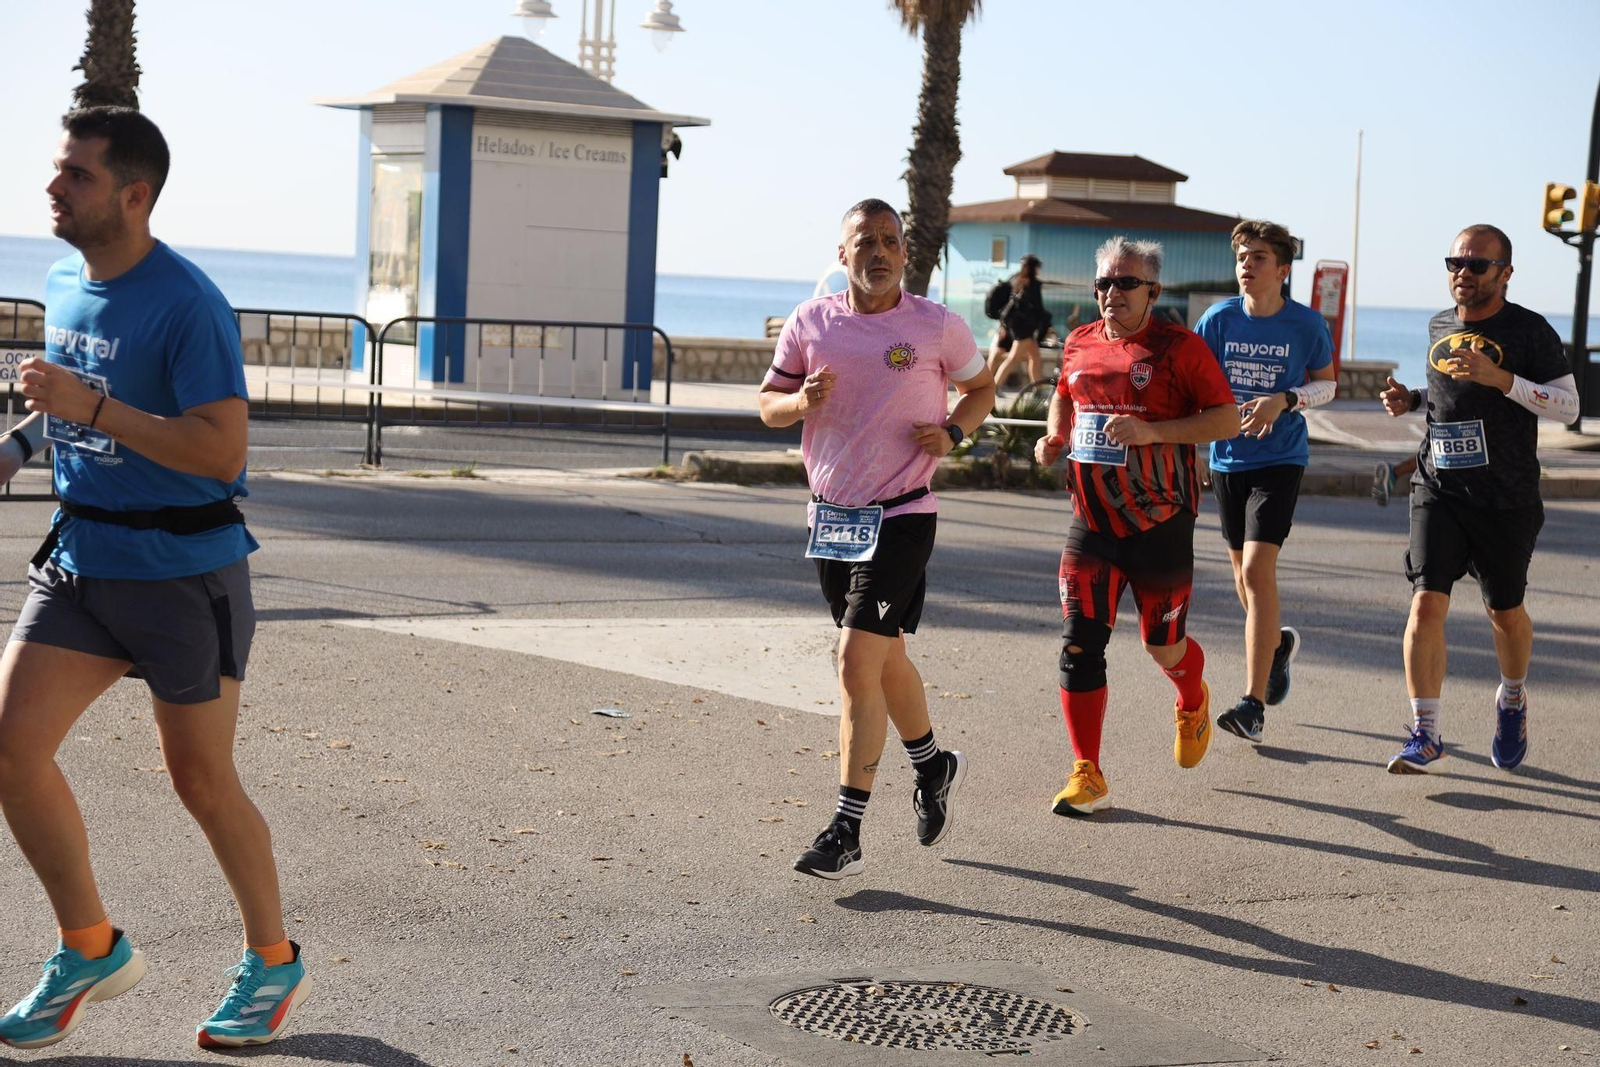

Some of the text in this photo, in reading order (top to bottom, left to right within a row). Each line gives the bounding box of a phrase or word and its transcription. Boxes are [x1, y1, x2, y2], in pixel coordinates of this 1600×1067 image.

[477, 135, 535, 156] Helados
[549, 141, 571, 160] Ice
[574, 143, 627, 163] Creams
[46, 325, 120, 360] mayoral
[1225, 341, 1290, 358] mayoral
[1230, 375, 1276, 389] FRIENDS
[1231, 367, 1276, 381] MAKES
[1435, 439, 1478, 454] 1868
[820, 525, 871, 542] 2118
